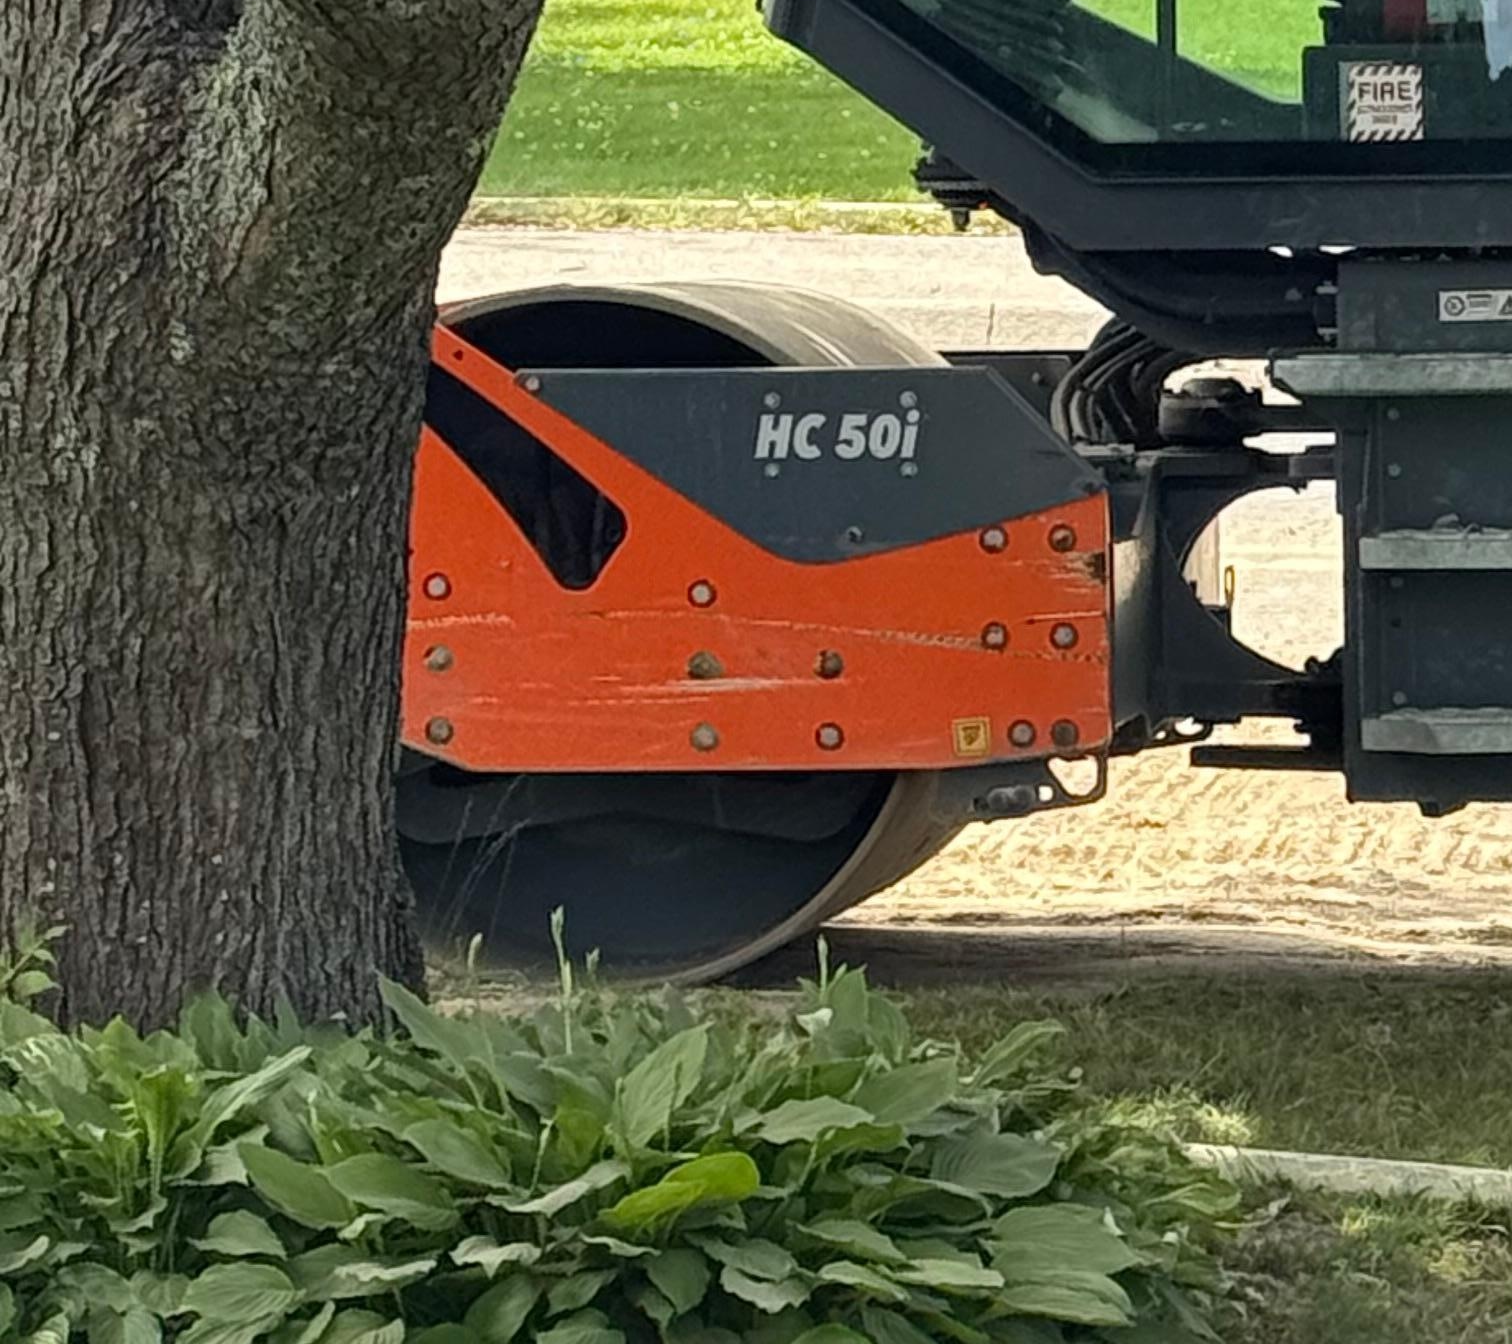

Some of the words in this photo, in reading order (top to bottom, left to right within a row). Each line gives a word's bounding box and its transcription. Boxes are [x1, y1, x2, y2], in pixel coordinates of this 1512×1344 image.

[1357, 80, 1413, 102] FIRE
[753, 412, 827, 460] HC
[834, 408, 920, 460] 50i
